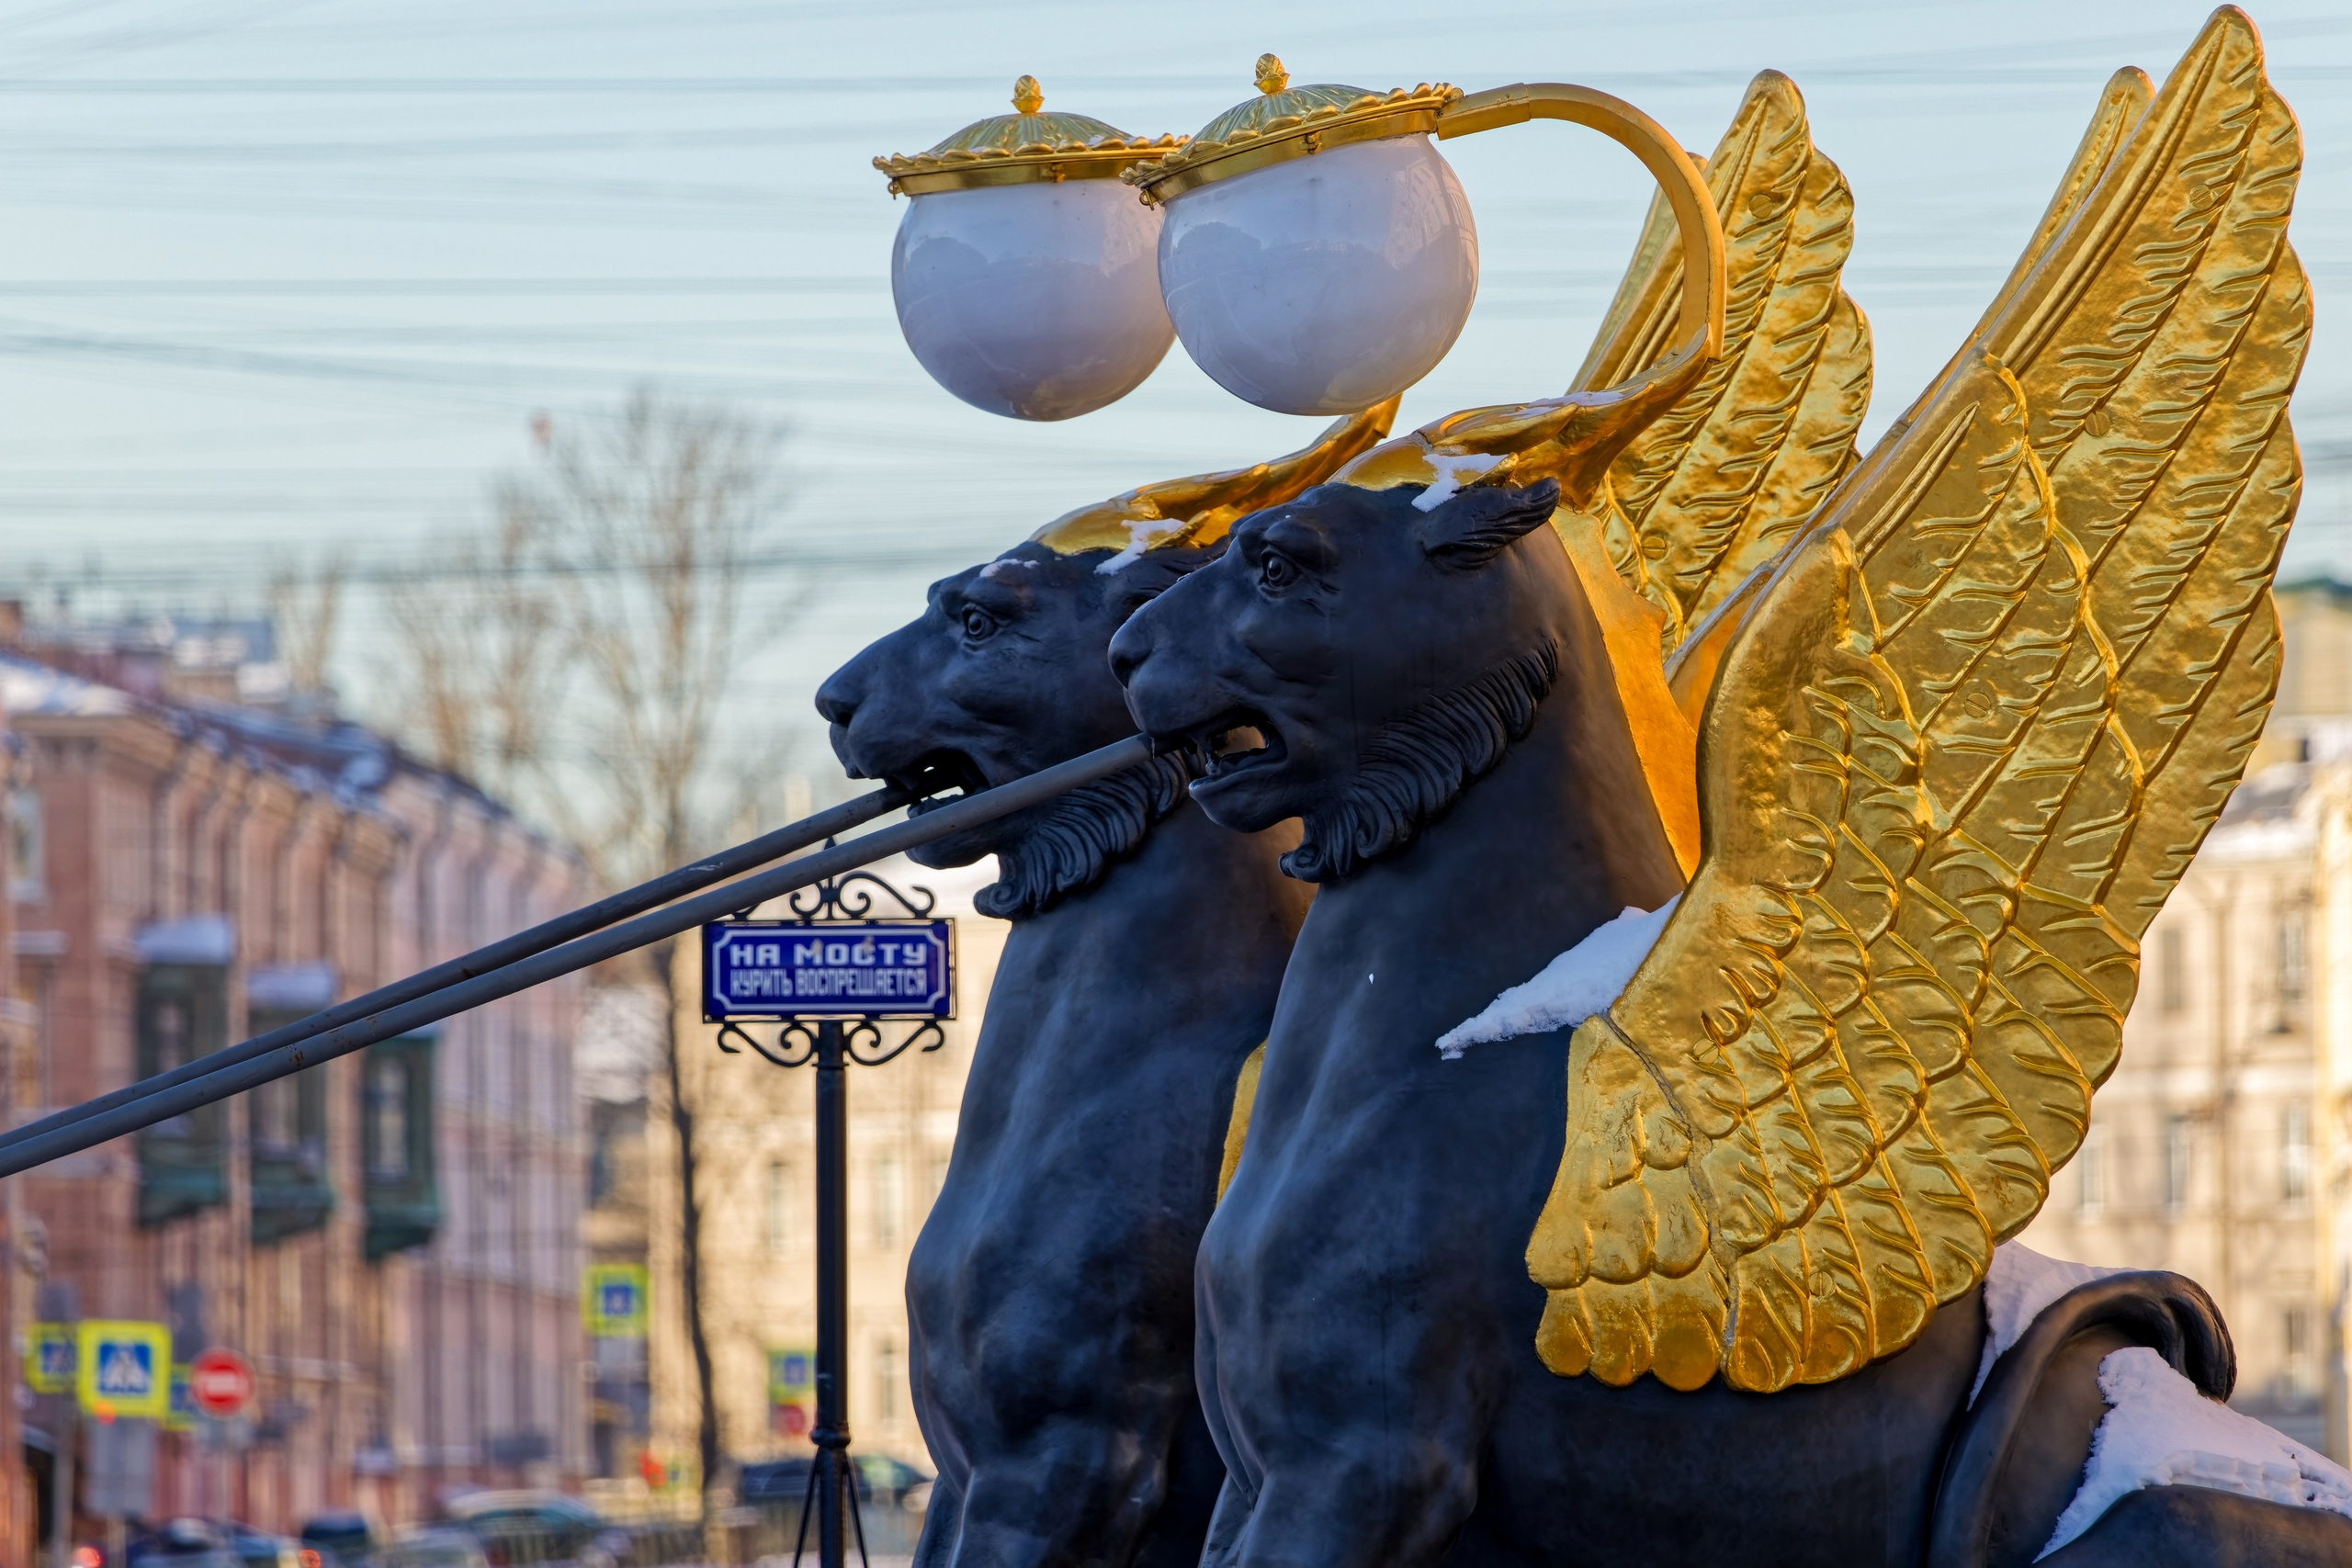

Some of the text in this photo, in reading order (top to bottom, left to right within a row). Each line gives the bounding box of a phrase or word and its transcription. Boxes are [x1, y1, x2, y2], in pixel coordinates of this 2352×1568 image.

[730, 943, 927, 966] НА МОСТУ
[730, 968, 927, 997] КУРИТЬ ВОСПРЕЩАЕТСЯ
